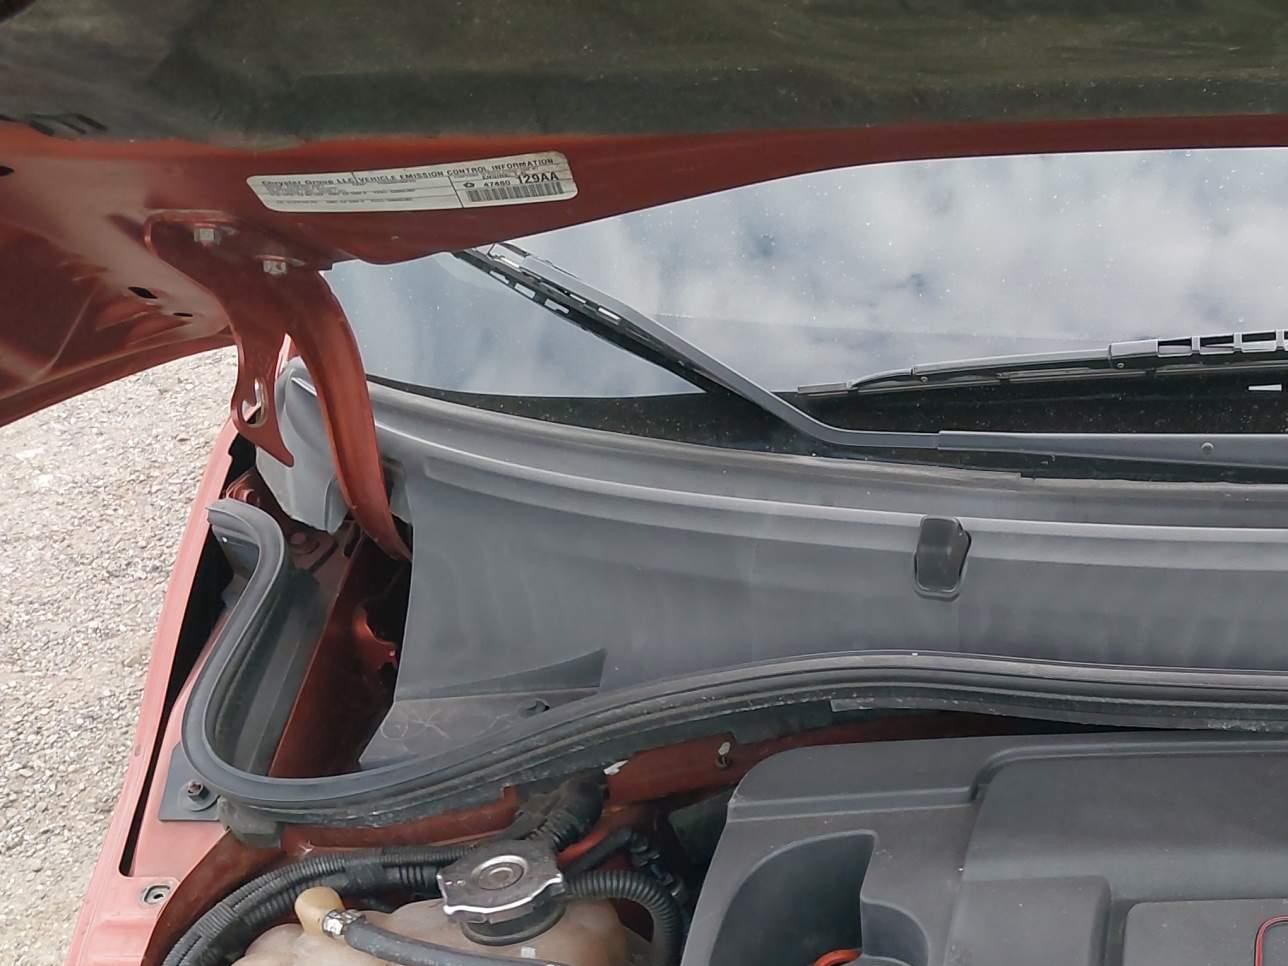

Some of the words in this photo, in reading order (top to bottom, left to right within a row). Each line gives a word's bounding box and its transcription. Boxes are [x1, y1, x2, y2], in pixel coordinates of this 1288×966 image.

[358, 175, 396, 183] VEHICLE
[399, 170, 444, 180] EMISSION
[446, 166, 487, 176] CONTROL
[491, 158, 554, 171] INFORMATION
[517, 171, 560, 185] 129AA
